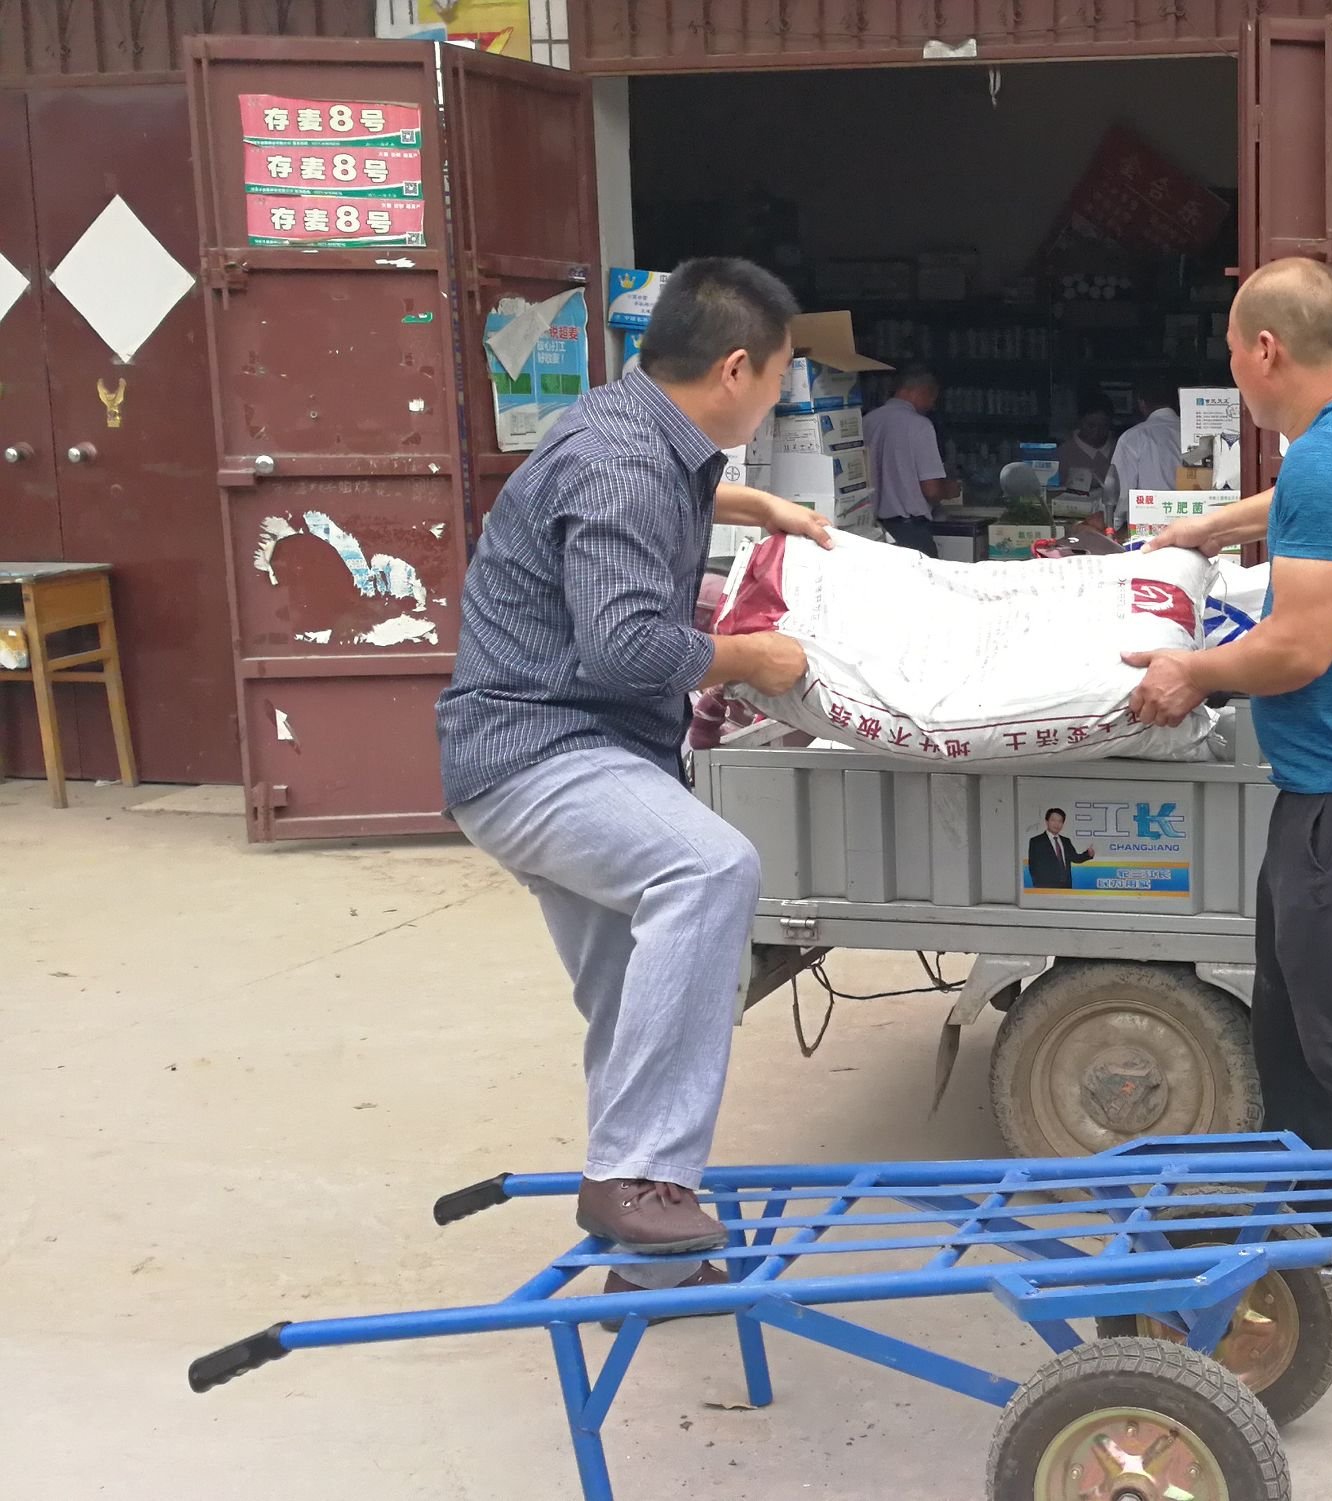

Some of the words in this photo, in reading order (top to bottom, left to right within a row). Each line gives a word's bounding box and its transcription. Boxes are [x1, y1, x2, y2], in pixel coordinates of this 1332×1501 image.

[264, 104, 385, 132] 存麦8号
[267, 153, 389, 183] 存麦8号
[270, 205, 391, 234] 存麦8号
[1162, 501, 1204, 515] 节肥菌
[1109, 843, 1180, 852] CHANGJIANG
